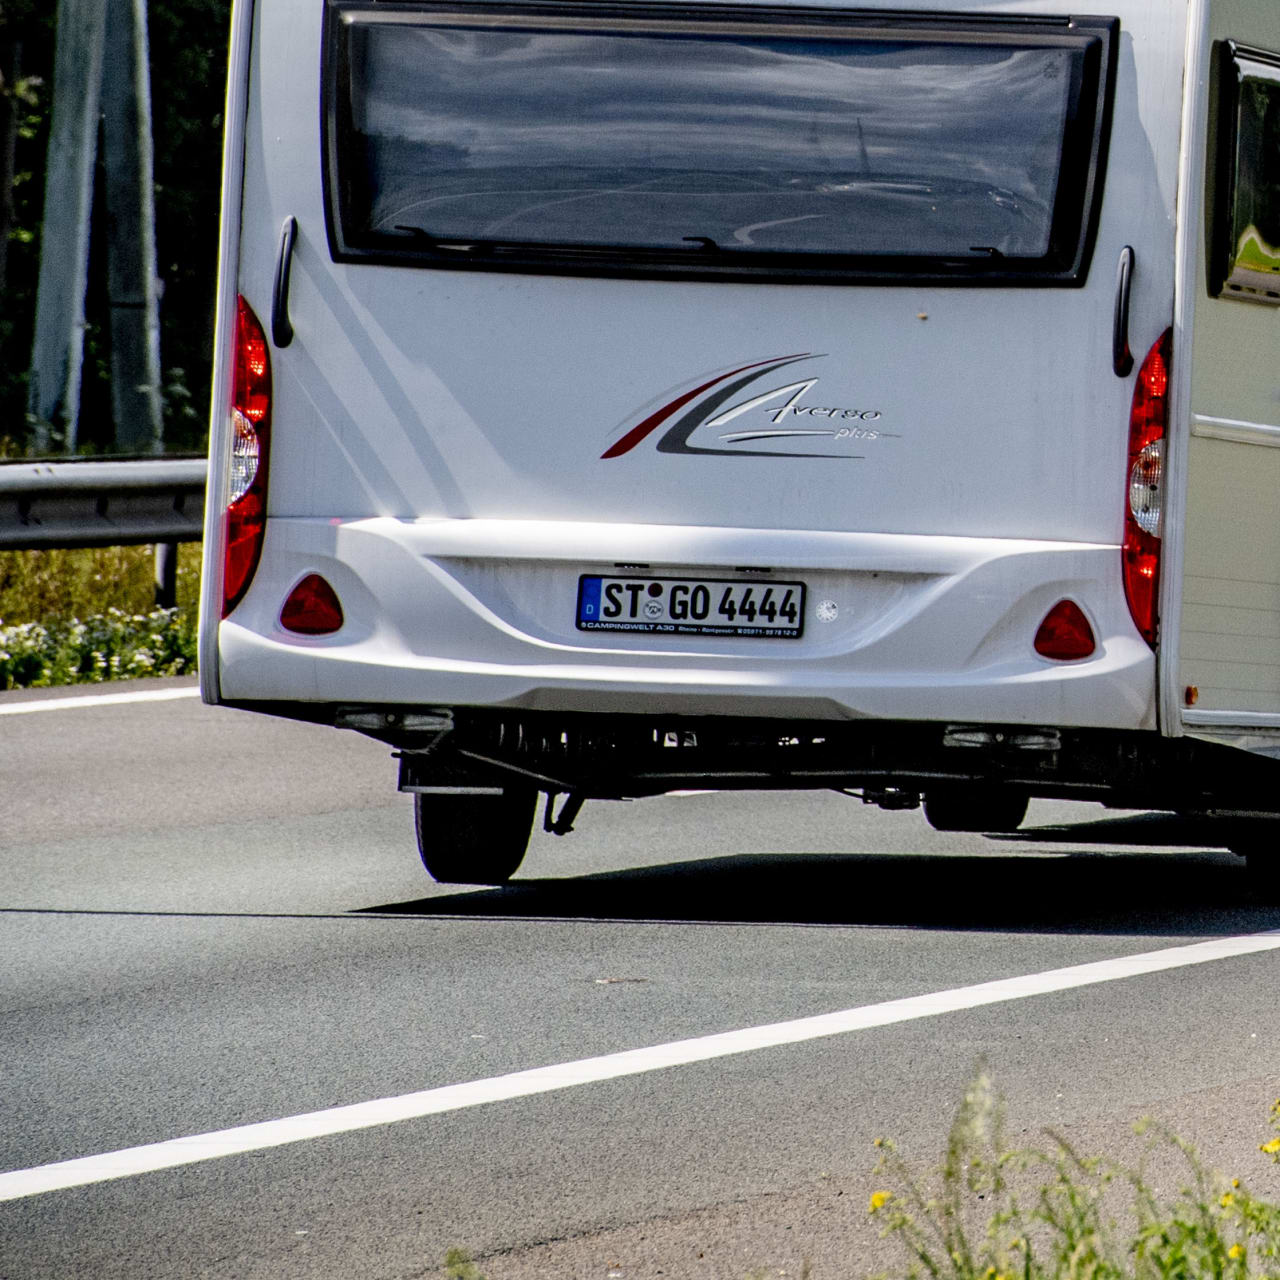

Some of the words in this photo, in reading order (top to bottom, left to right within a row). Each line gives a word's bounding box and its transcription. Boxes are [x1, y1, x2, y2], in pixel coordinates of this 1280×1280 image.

[705, 377, 882, 428] Averso
[834, 426, 880, 440] plus
[603, 583, 645, 618] ST
[669, 585, 710, 620] GO
[718, 587, 797, 624] 4444
[587, 622, 655, 631] CAMPINGWELT
